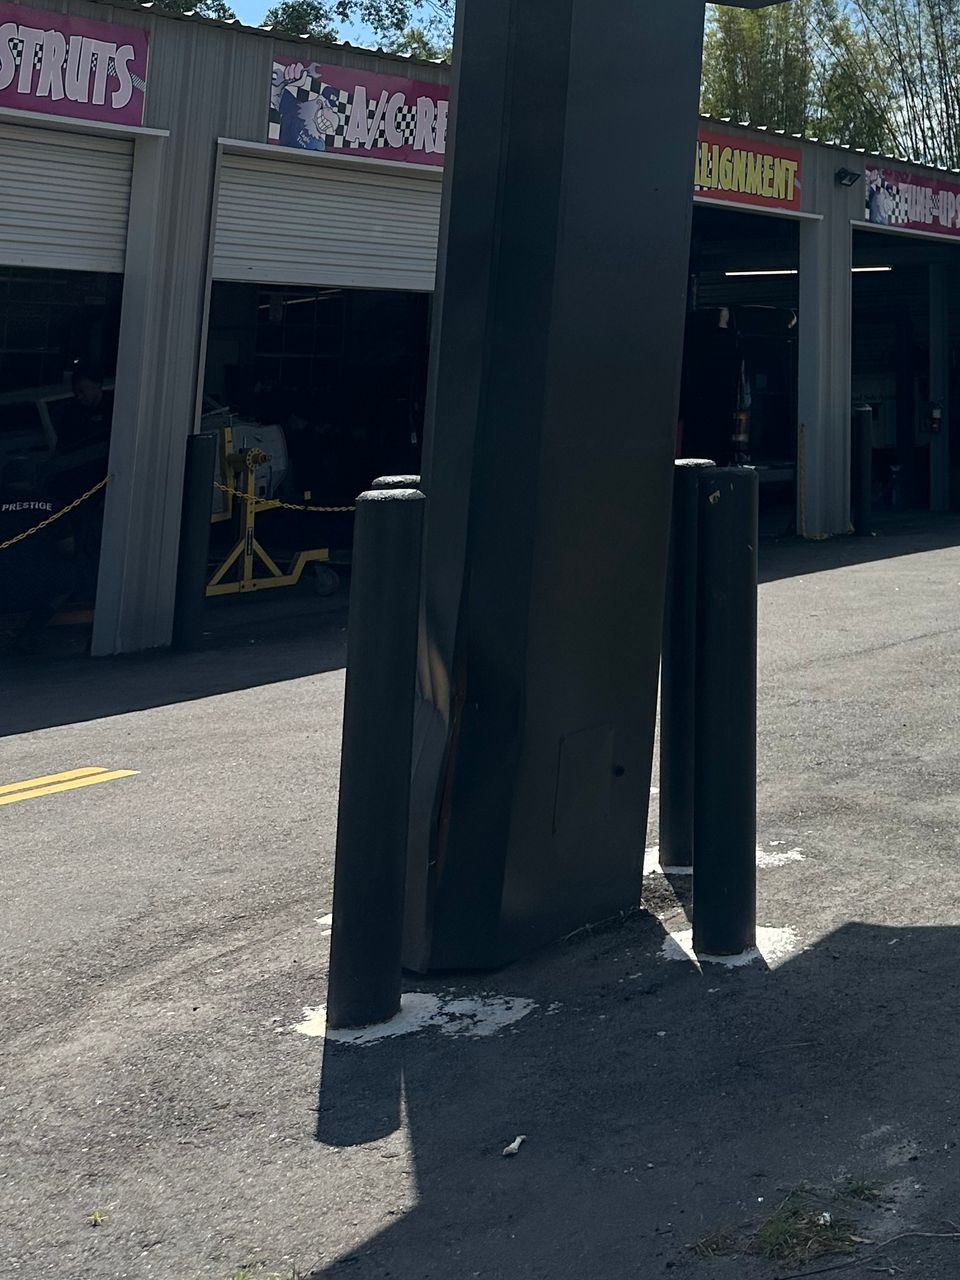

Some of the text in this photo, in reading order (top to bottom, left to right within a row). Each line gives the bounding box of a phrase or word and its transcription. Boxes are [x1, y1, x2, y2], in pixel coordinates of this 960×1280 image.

[0, 22, 135, 109] STRUTS
[345, 85, 406, 150] A/C
[2, 501, 53, 511] PRESTIGE
